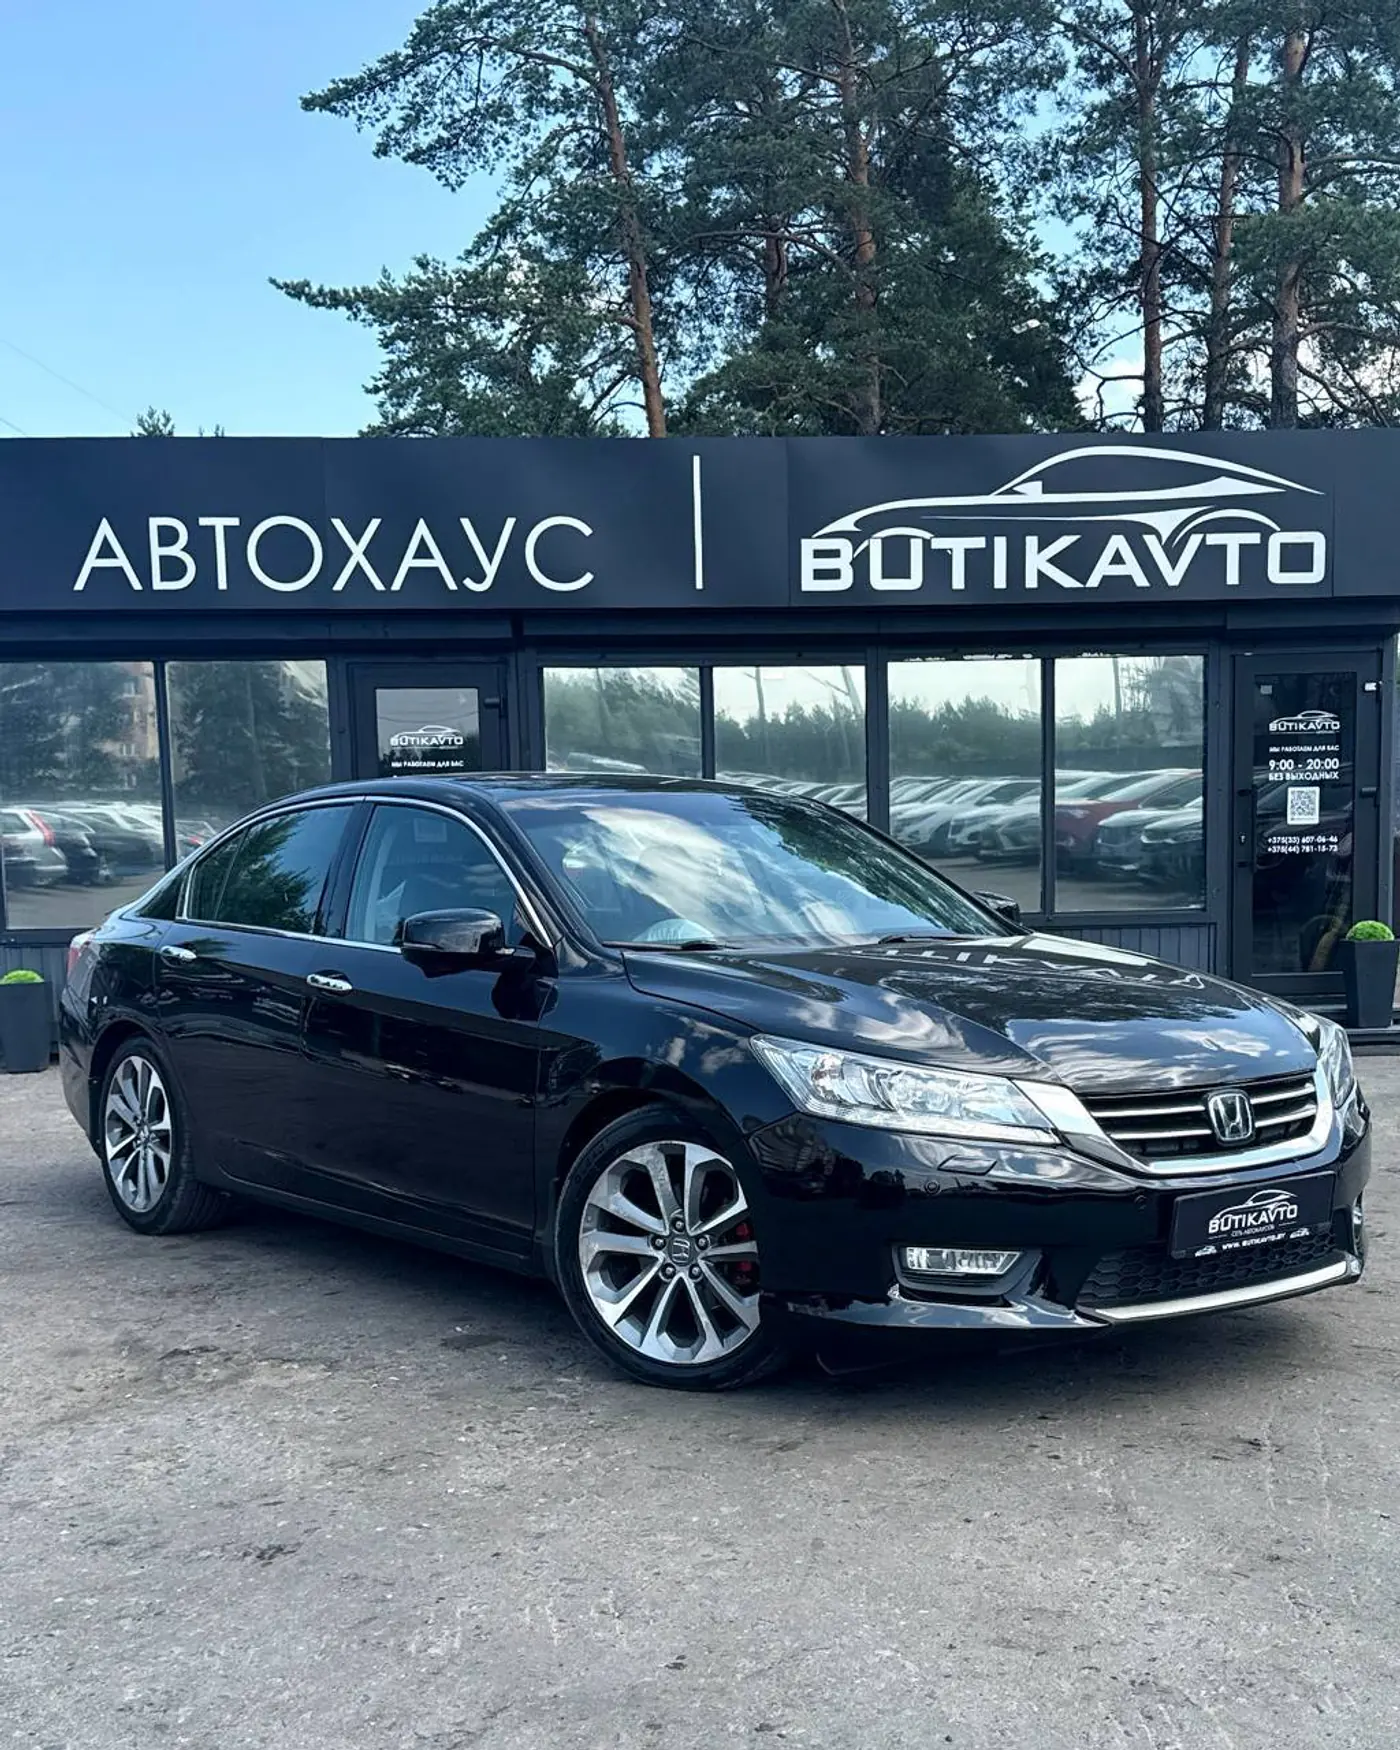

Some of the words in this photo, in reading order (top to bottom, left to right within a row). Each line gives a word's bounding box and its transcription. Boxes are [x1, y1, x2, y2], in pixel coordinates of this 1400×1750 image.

[73, 515, 595, 592] АВТОХАУС
[800, 528, 1326, 592] BUTIKAVTO
[1269, 721, 1341, 731] BUTIKAVTO
[390, 736, 464, 746] BUTIKAVTO
[1268, 759, 1294, 770] 9:00
[1305, 758, 1340, 770] 20:00
[1268, 772, 1284, 781] БЕЗ
[1285, 771, 1340, 781] ВЫХОДНЫХ
[1208, 1204, 1298, 1234] BUTIKAVTO
